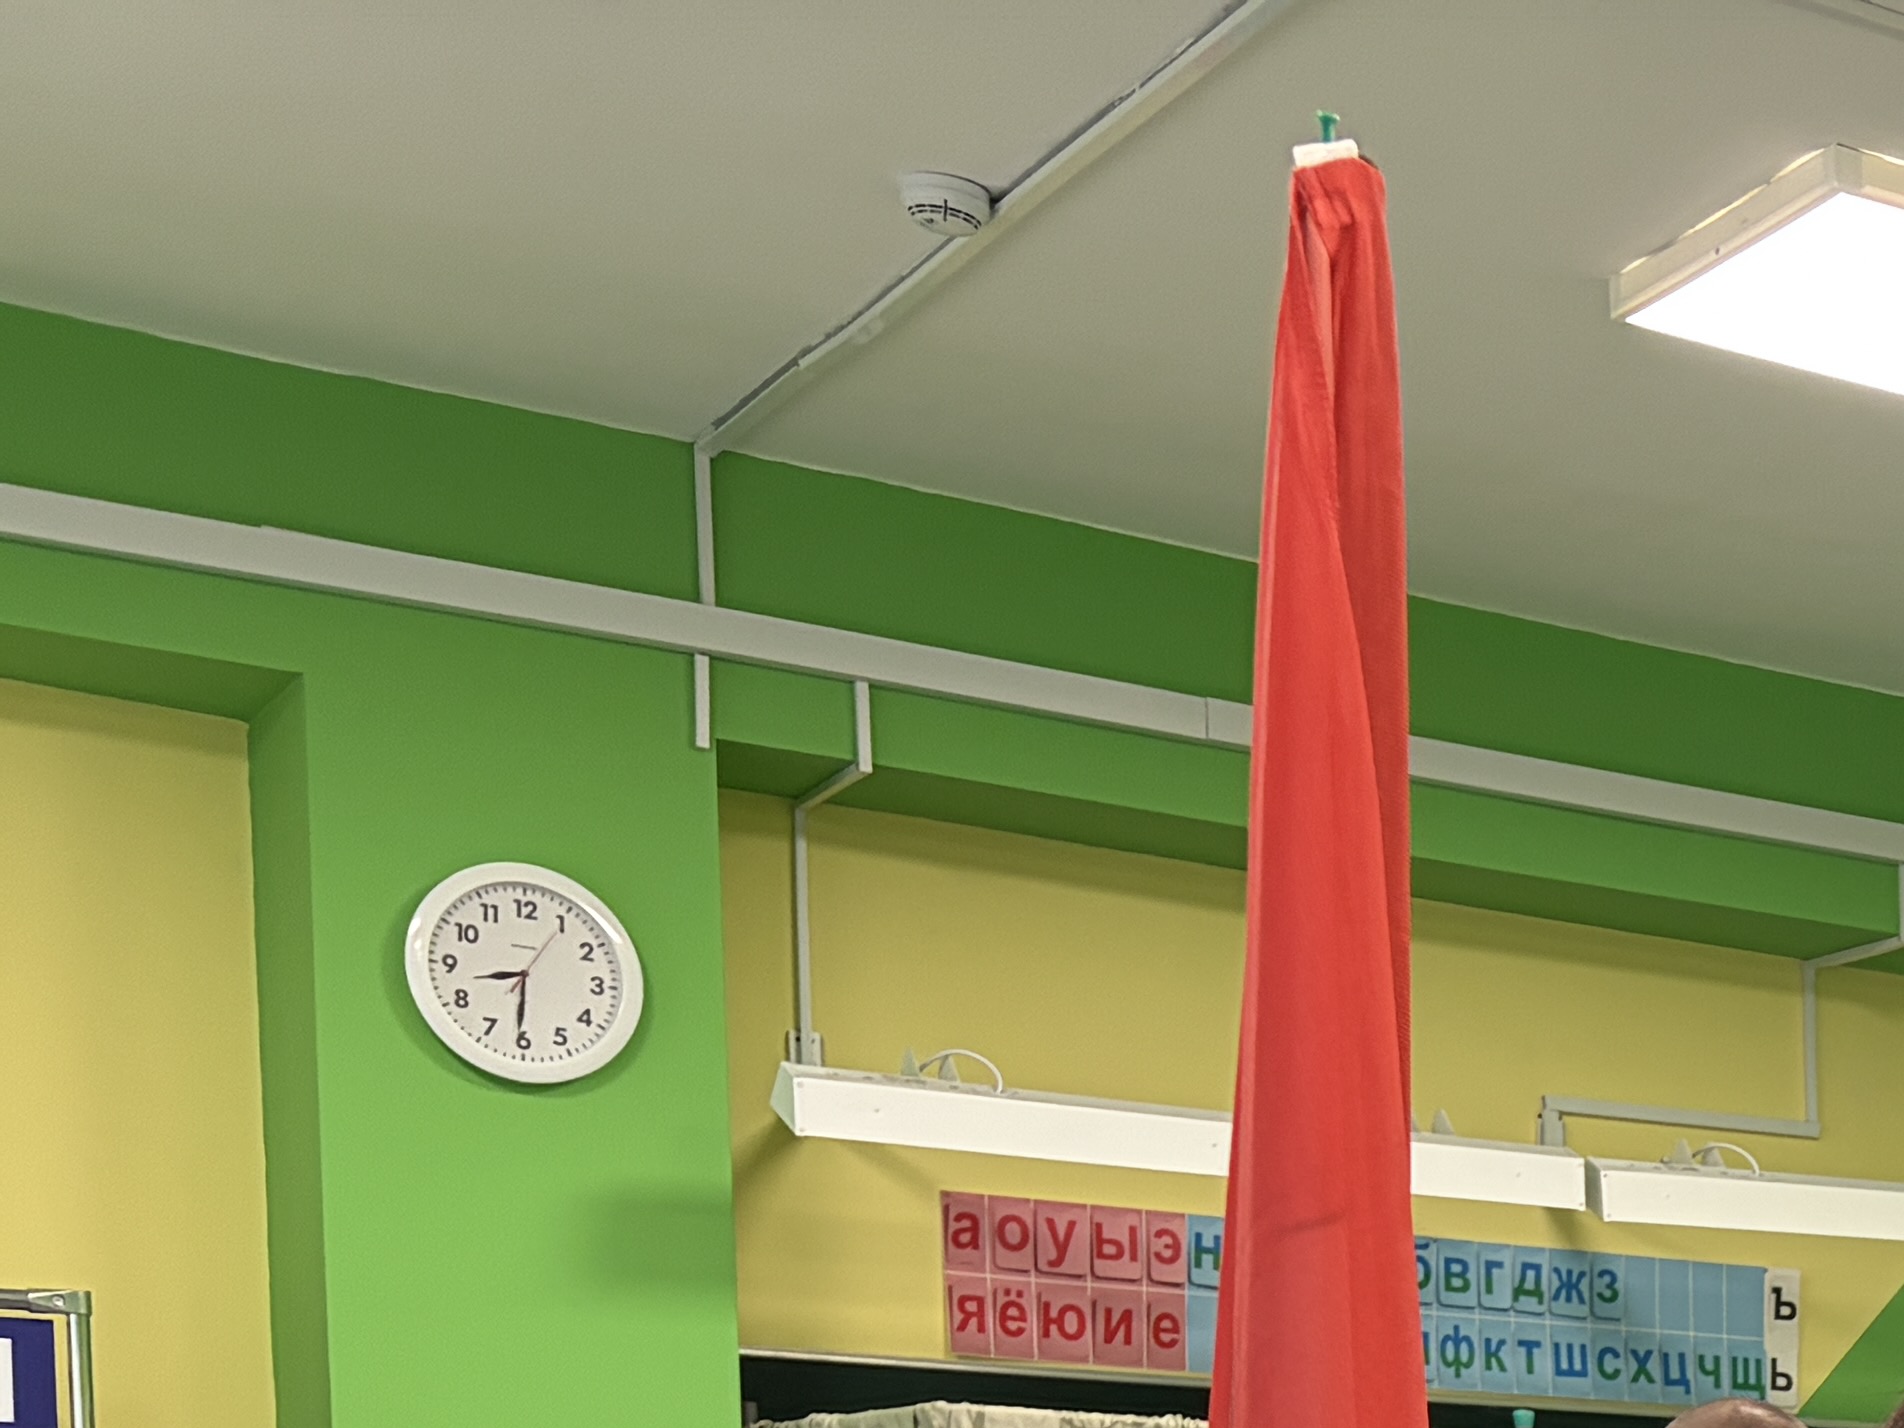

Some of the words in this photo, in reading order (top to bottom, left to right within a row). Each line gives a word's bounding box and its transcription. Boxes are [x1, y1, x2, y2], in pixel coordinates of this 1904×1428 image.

[480, 903, 499, 924] 11
[513, 898, 538, 920] 12
[454, 922, 479, 944] 10
[555, 914, 565, 934] 1
[579, 941, 594, 962] 2
[441, 954, 458, 973] 9
[590, 976, 605, 996] 3
[454, 988, 469, 1009] 8
[482, 1016, 499, 1036] 7
[576, 1008, 592, 1027] 4
[516, 1030, 531, 1050] 6
[552, 1027, 567, 1046] 5
